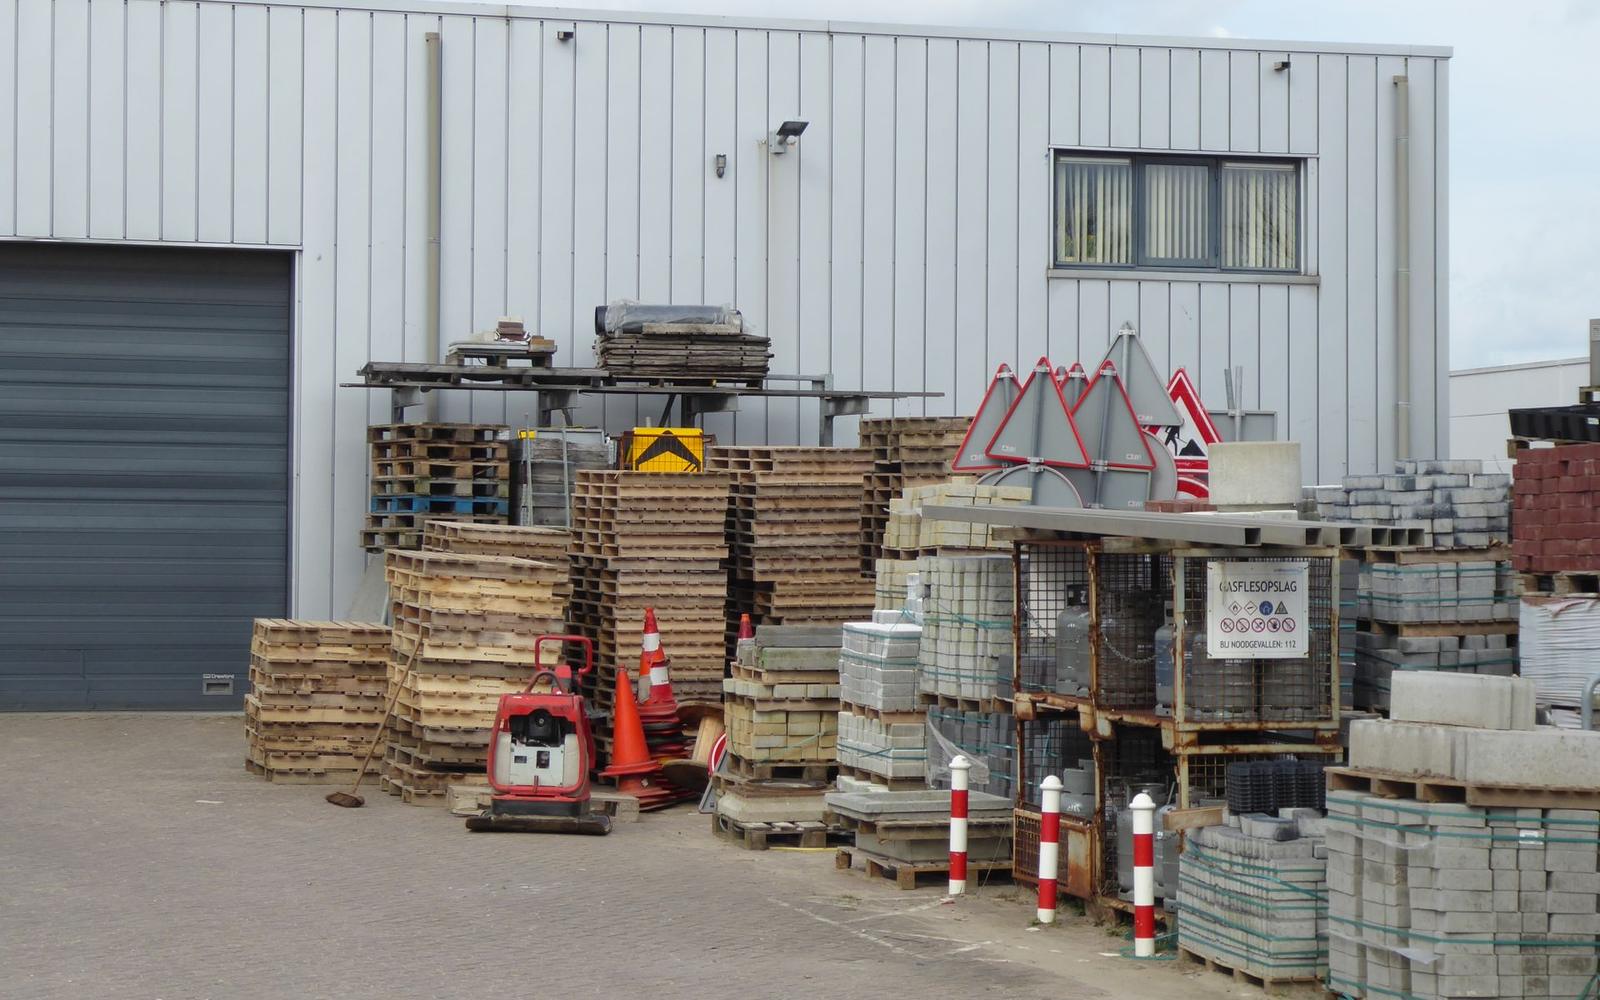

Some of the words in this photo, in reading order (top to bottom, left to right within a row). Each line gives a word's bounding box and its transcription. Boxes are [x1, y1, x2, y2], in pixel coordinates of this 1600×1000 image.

[1220, 640, 1230, 648] BIJ
[1231, 640, 1283, 648] NOODGEVALLEN:
[1285, 640, 1296, 648] 112
